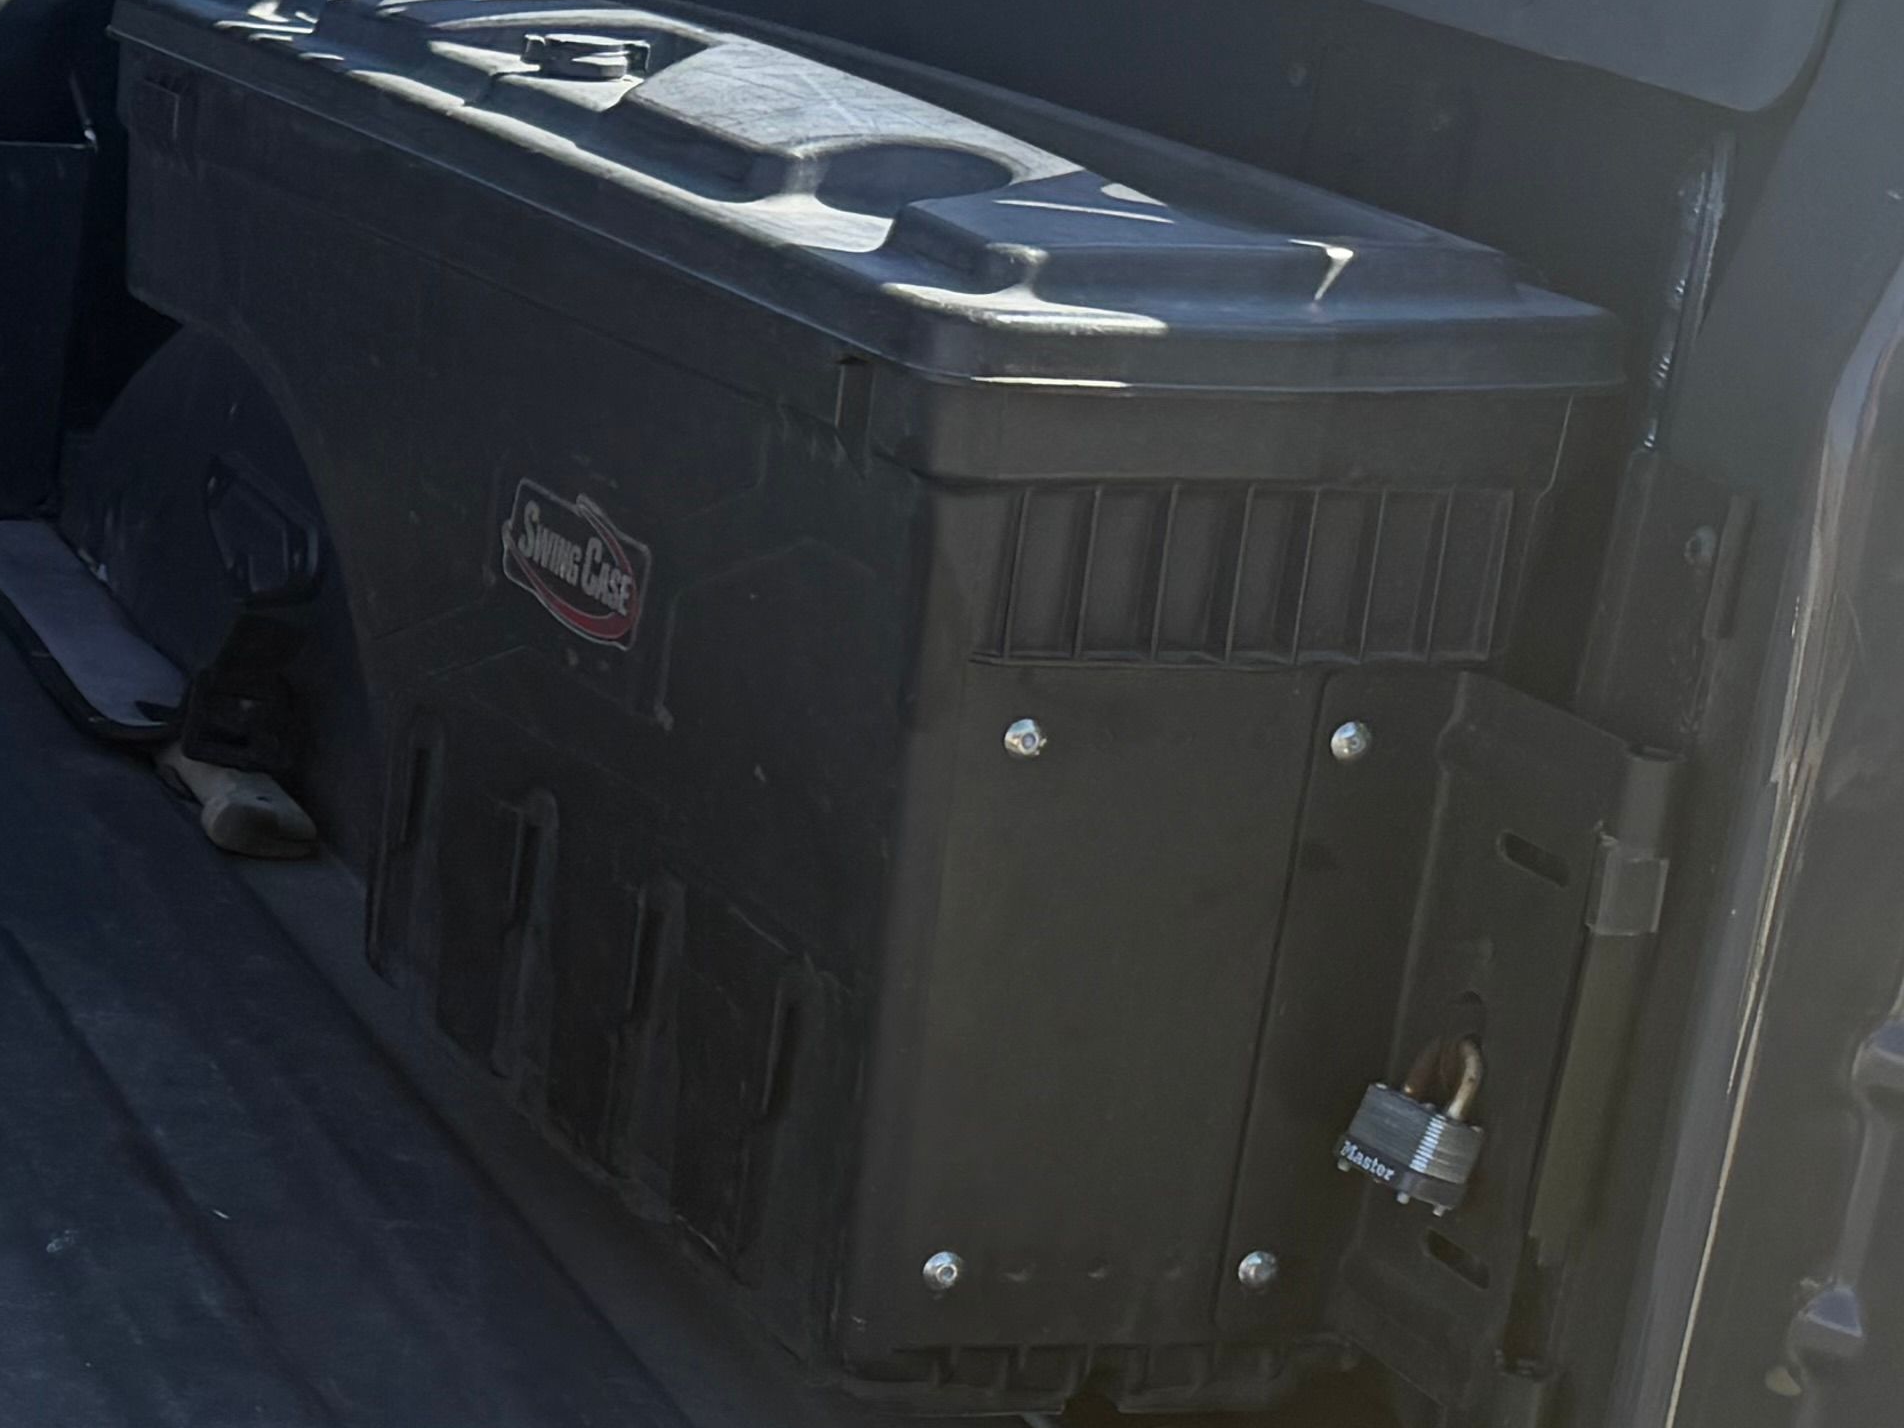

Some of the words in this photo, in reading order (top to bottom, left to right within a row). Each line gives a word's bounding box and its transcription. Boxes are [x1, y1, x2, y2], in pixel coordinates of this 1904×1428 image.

[518, 499, 582, 587] SWING
[581, 536, 632, 616] CASE
[1340, 1139, 1395, 1181] Master
